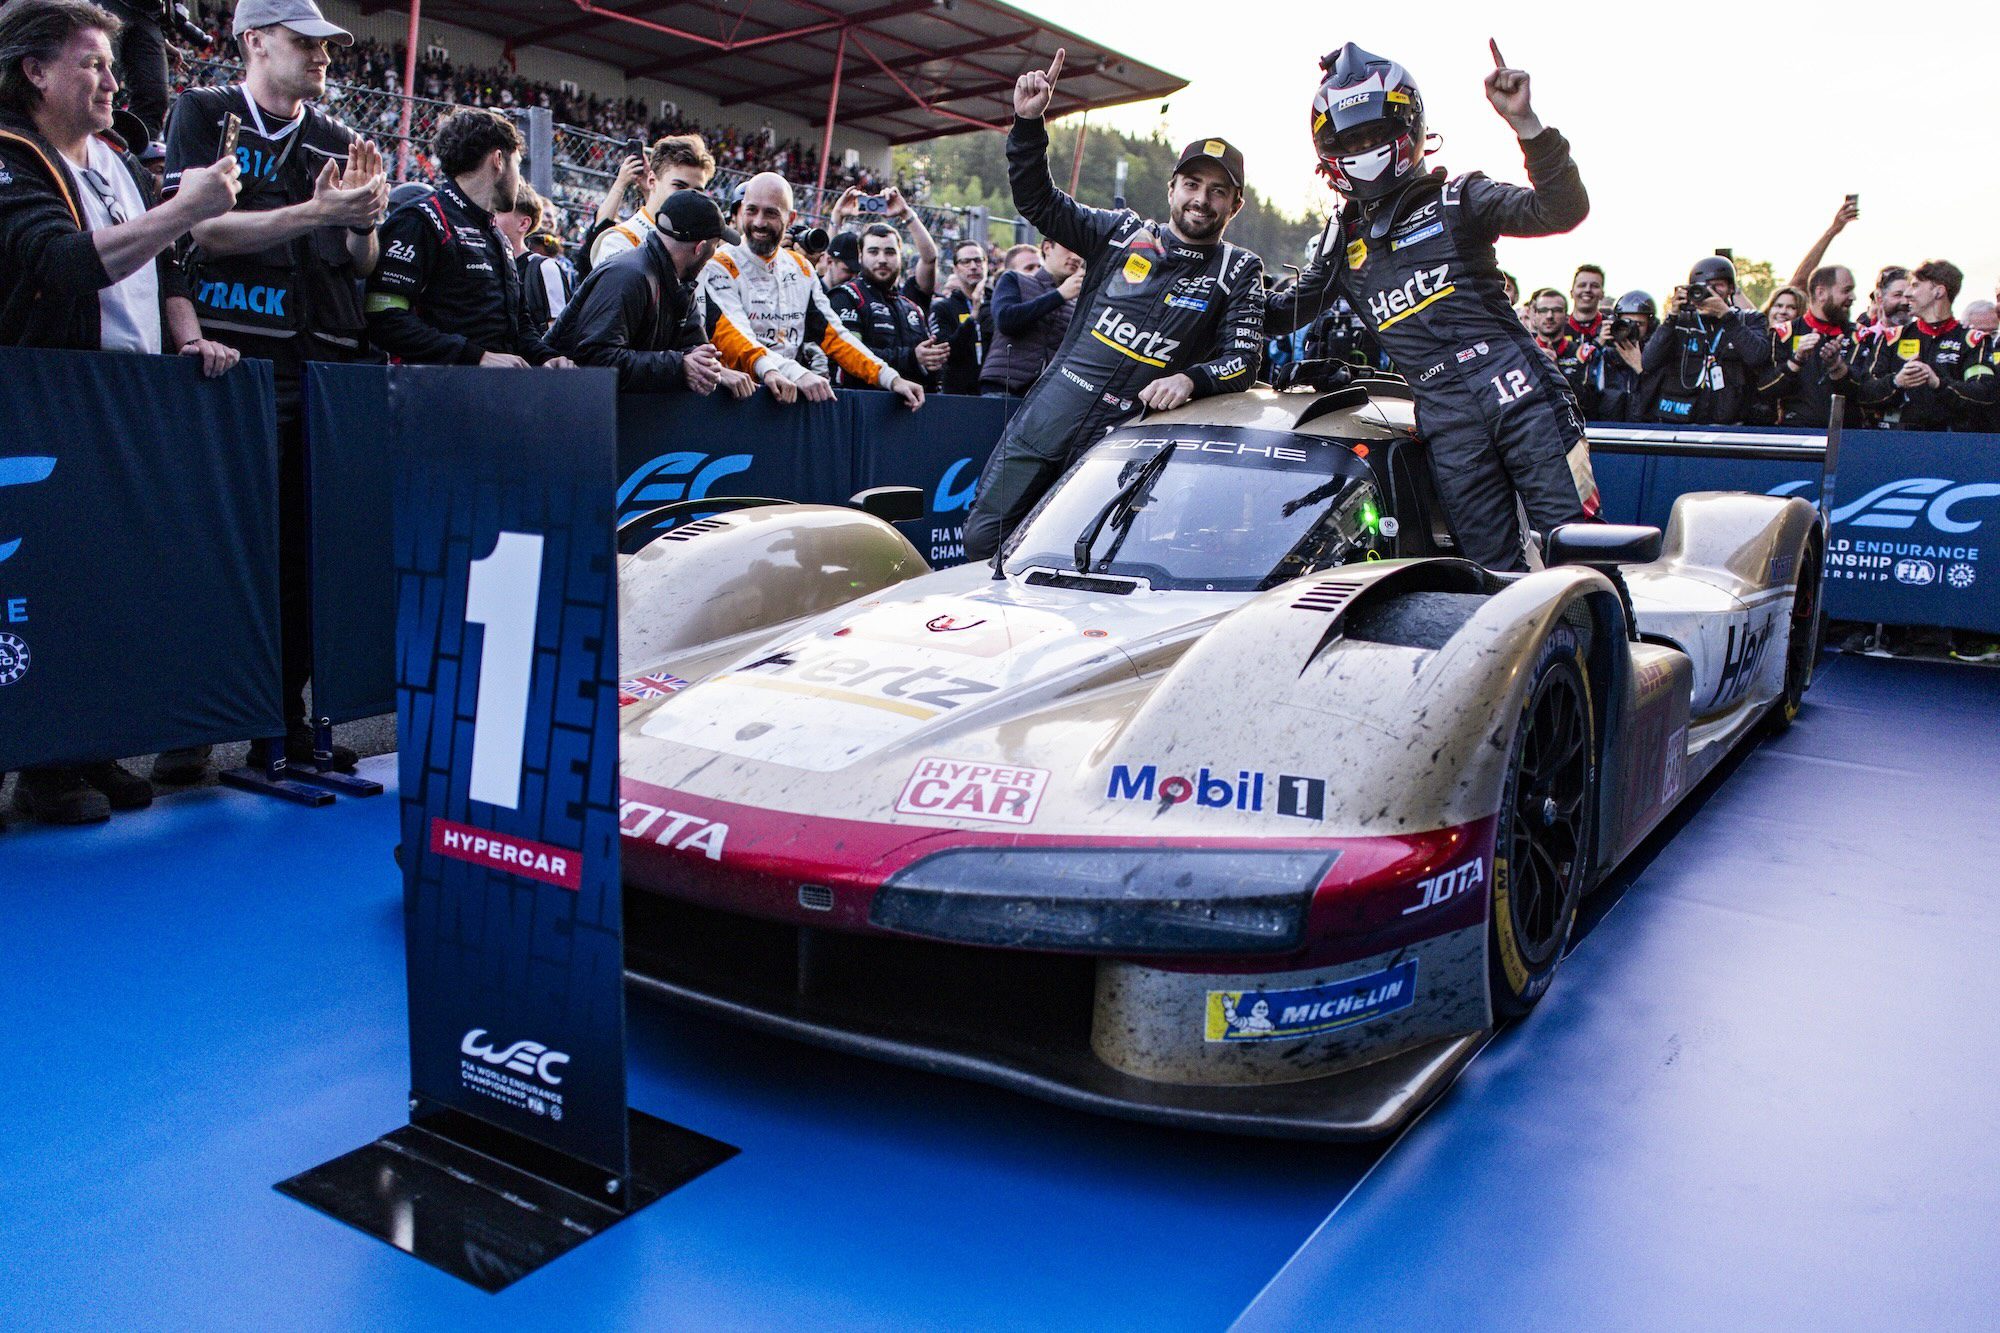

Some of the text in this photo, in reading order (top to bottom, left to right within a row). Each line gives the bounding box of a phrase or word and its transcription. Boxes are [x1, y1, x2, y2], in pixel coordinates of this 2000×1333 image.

[1338, 93, 1370, 111] Hertz
[1172, 247, 1204, 260] JOTA
[1229, 252, 1252, 281] HRX
[198, 279, 287, 317] TRACK
[1368, 264, 1452, 325] Hertz
[1095, 306, 1181, 362] Hertz
[1061, 366, 1094, 391] W.STEVENS
[1209, 357, 1246, 377] Hertz
[1491, 369, 1532, 405] 12
[1100, 439, 1306, 462] PORSCHE
[931, 527, 951, 543] FIA
[1856, 540, 1978, 561] ENDURANCE
[465, 531, 544, 810] 1
[736, 650, 1000, 709] Hertz
[921, 762, 1036, 788] HYPER
[1107, 765, 1264, 811] Mobil
[909, 779, 1031, 817] CAR
[618, 799, 729, 861] OTA
[444, 830, 567, 876] HYPERCAR
[1402, 857, 1483, 915] JOTA
[1280, 980, 1403, 1025] MICHELIN
[461, 1028, 570, 1085] WEC
[462, 1070, 527, 1099] CHAMPIONSHIP
[477, 1066, 508, 1084] WORLD
[509, 1078, 563, 1104] ENDURANCE
